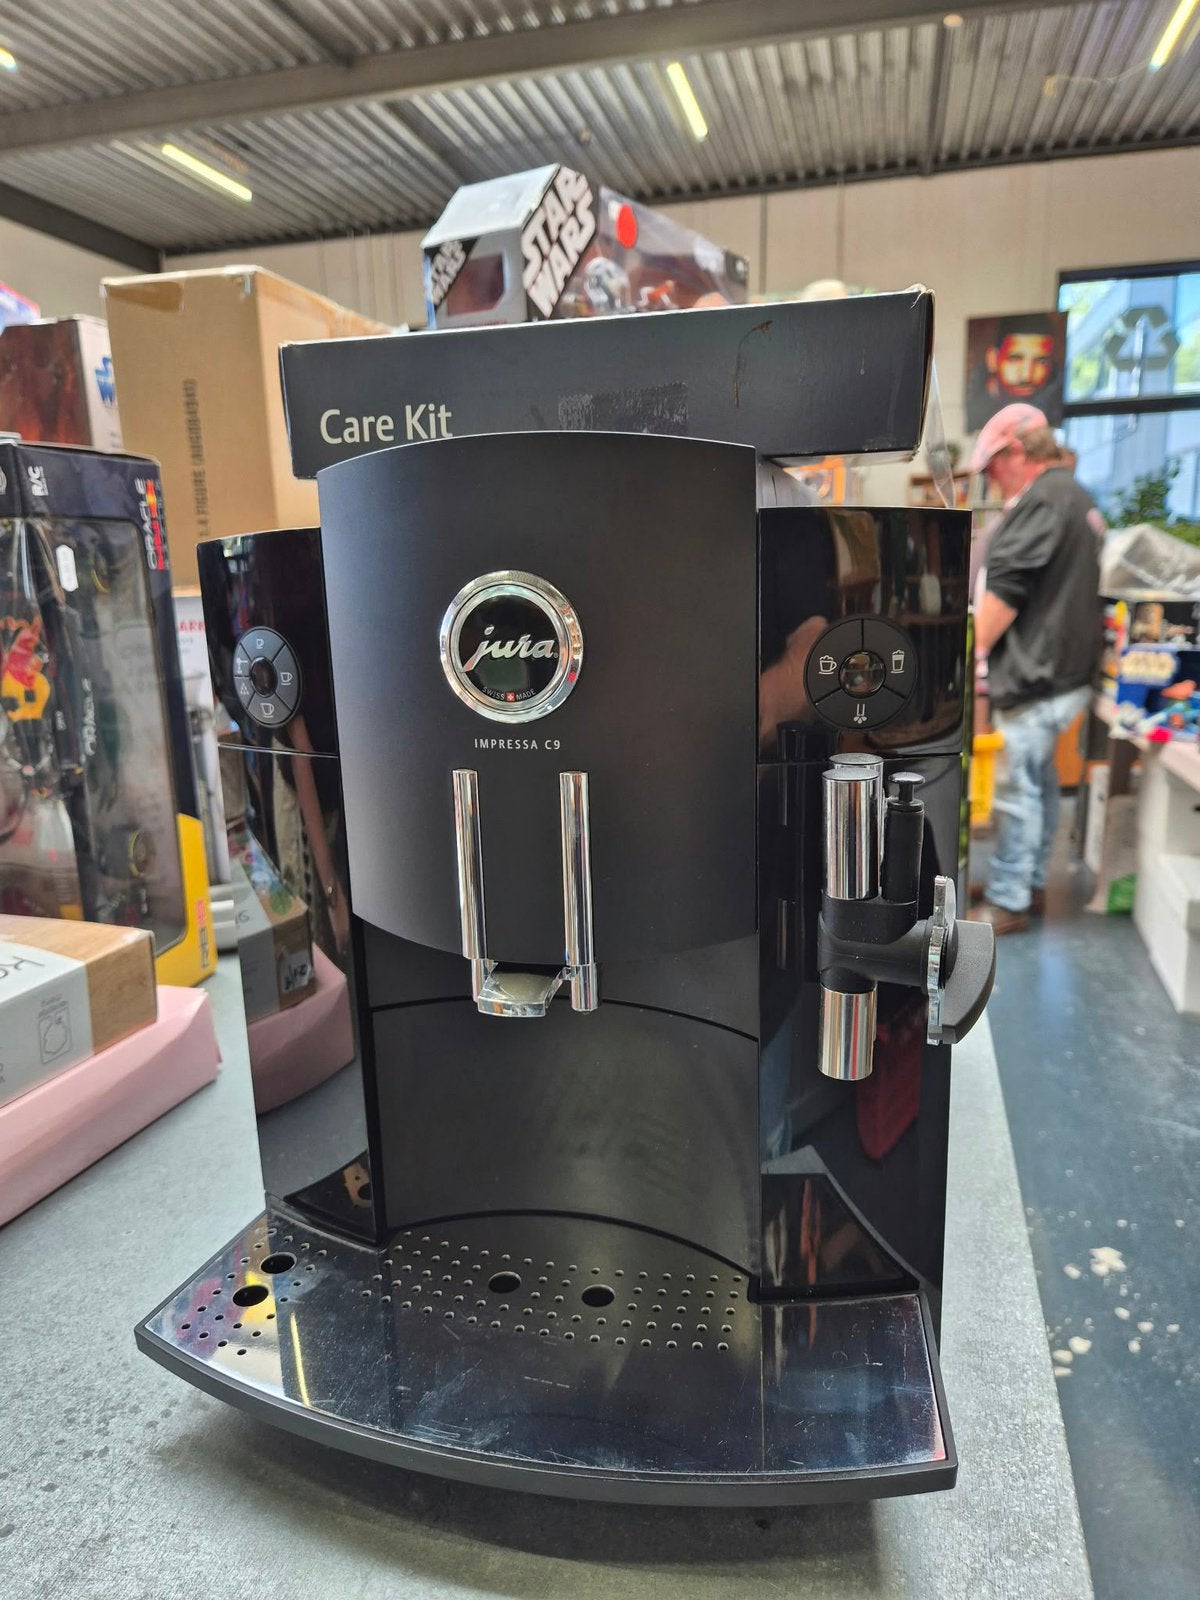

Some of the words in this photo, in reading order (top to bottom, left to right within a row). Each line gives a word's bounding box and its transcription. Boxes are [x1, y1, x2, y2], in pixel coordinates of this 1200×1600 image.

[521, 166, 589, 291] STAR
[528, 187, 596, 318] WARS
[320, 408, 394, 444] Care
[405, 403, 453, 440] Kit
[135, 478, 157, 570] ORACLE
[462, 626, 555, 673] jura
[482, 686, 505, 701] SWISS
[516, 688, 536, 700] MADE
[474, 738, 538, 750] IMPRESSA
[545, 740, 561, 750] C9
